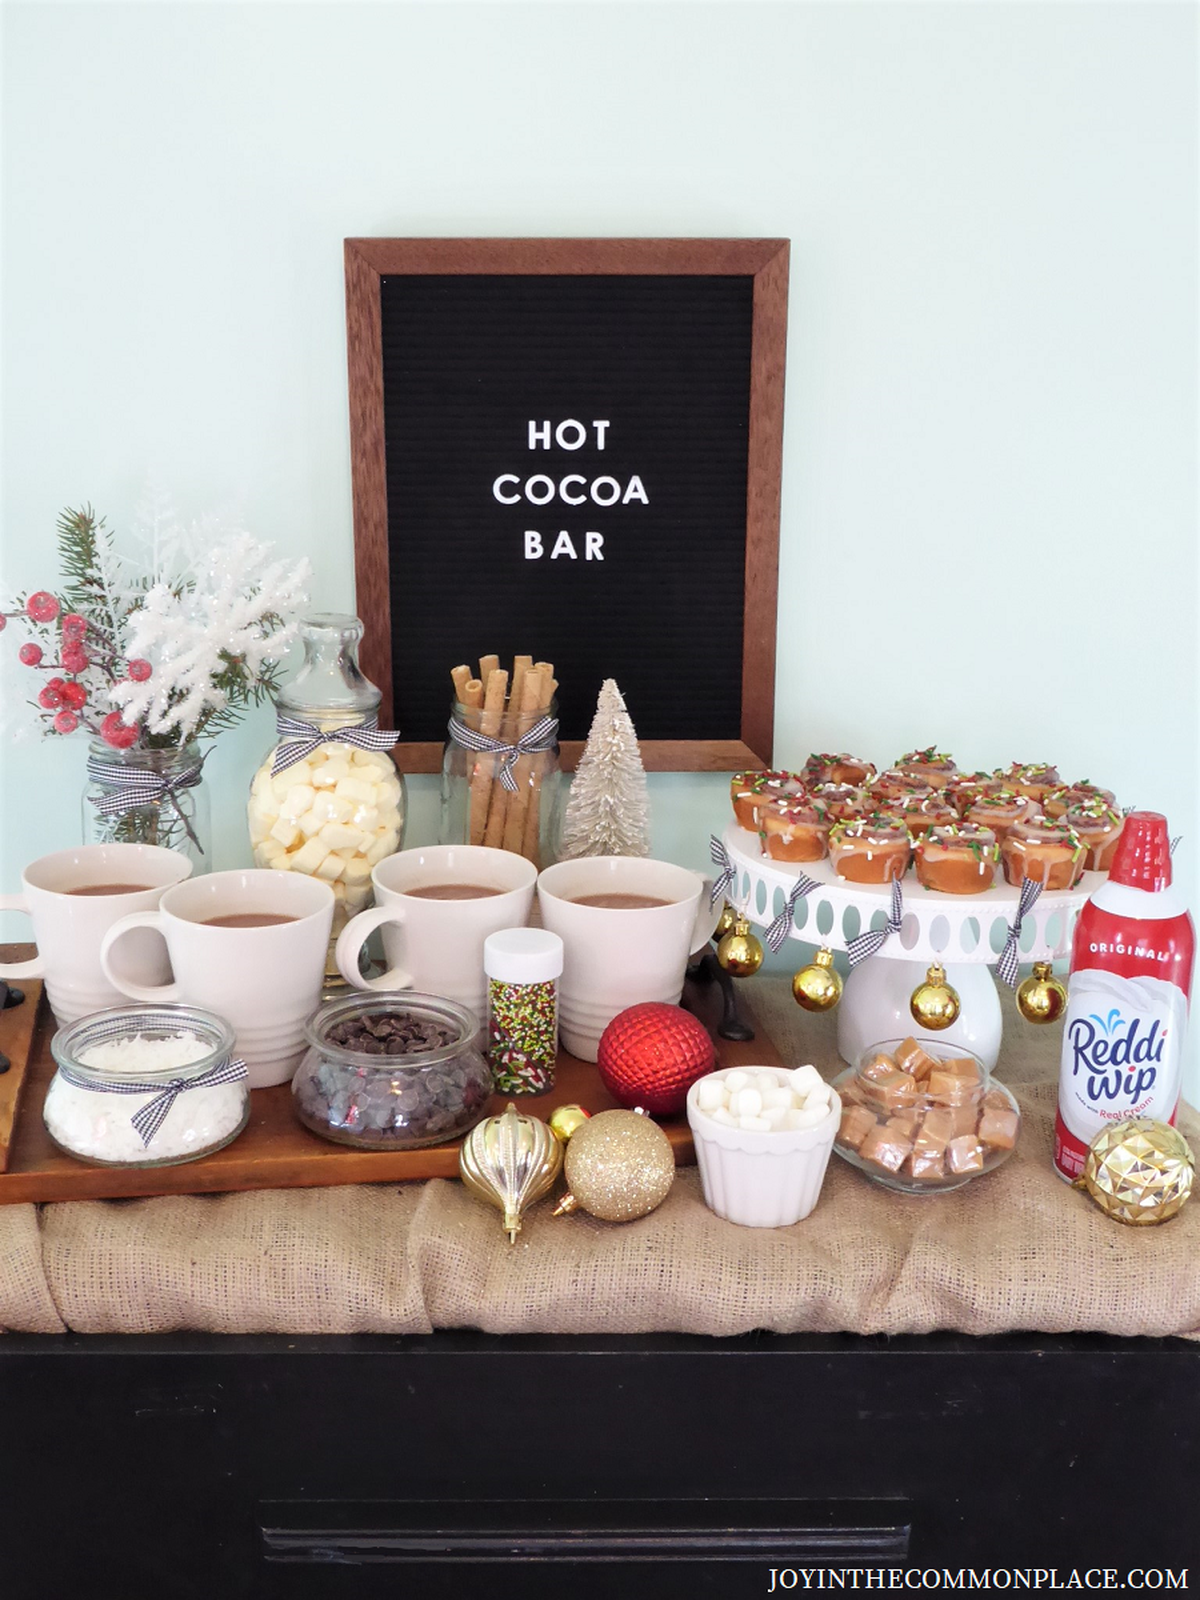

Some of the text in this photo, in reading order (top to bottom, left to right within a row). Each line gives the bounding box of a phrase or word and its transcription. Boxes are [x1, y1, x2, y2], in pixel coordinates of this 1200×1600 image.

[528, 419, 610, 451] HOT
[492, 473, 649, 507] COCOA
[524, 530, 605, 561] BAR
[1089, 942, 1165, 961] ORIGINAL
[1068, 1018, 1168, 1076] Reddi
[1087, 1065, 1157, 1105] wip
[1099, 1108, 1122, 1120] Real
[1123, 1096, 1154, 1117] Cream
